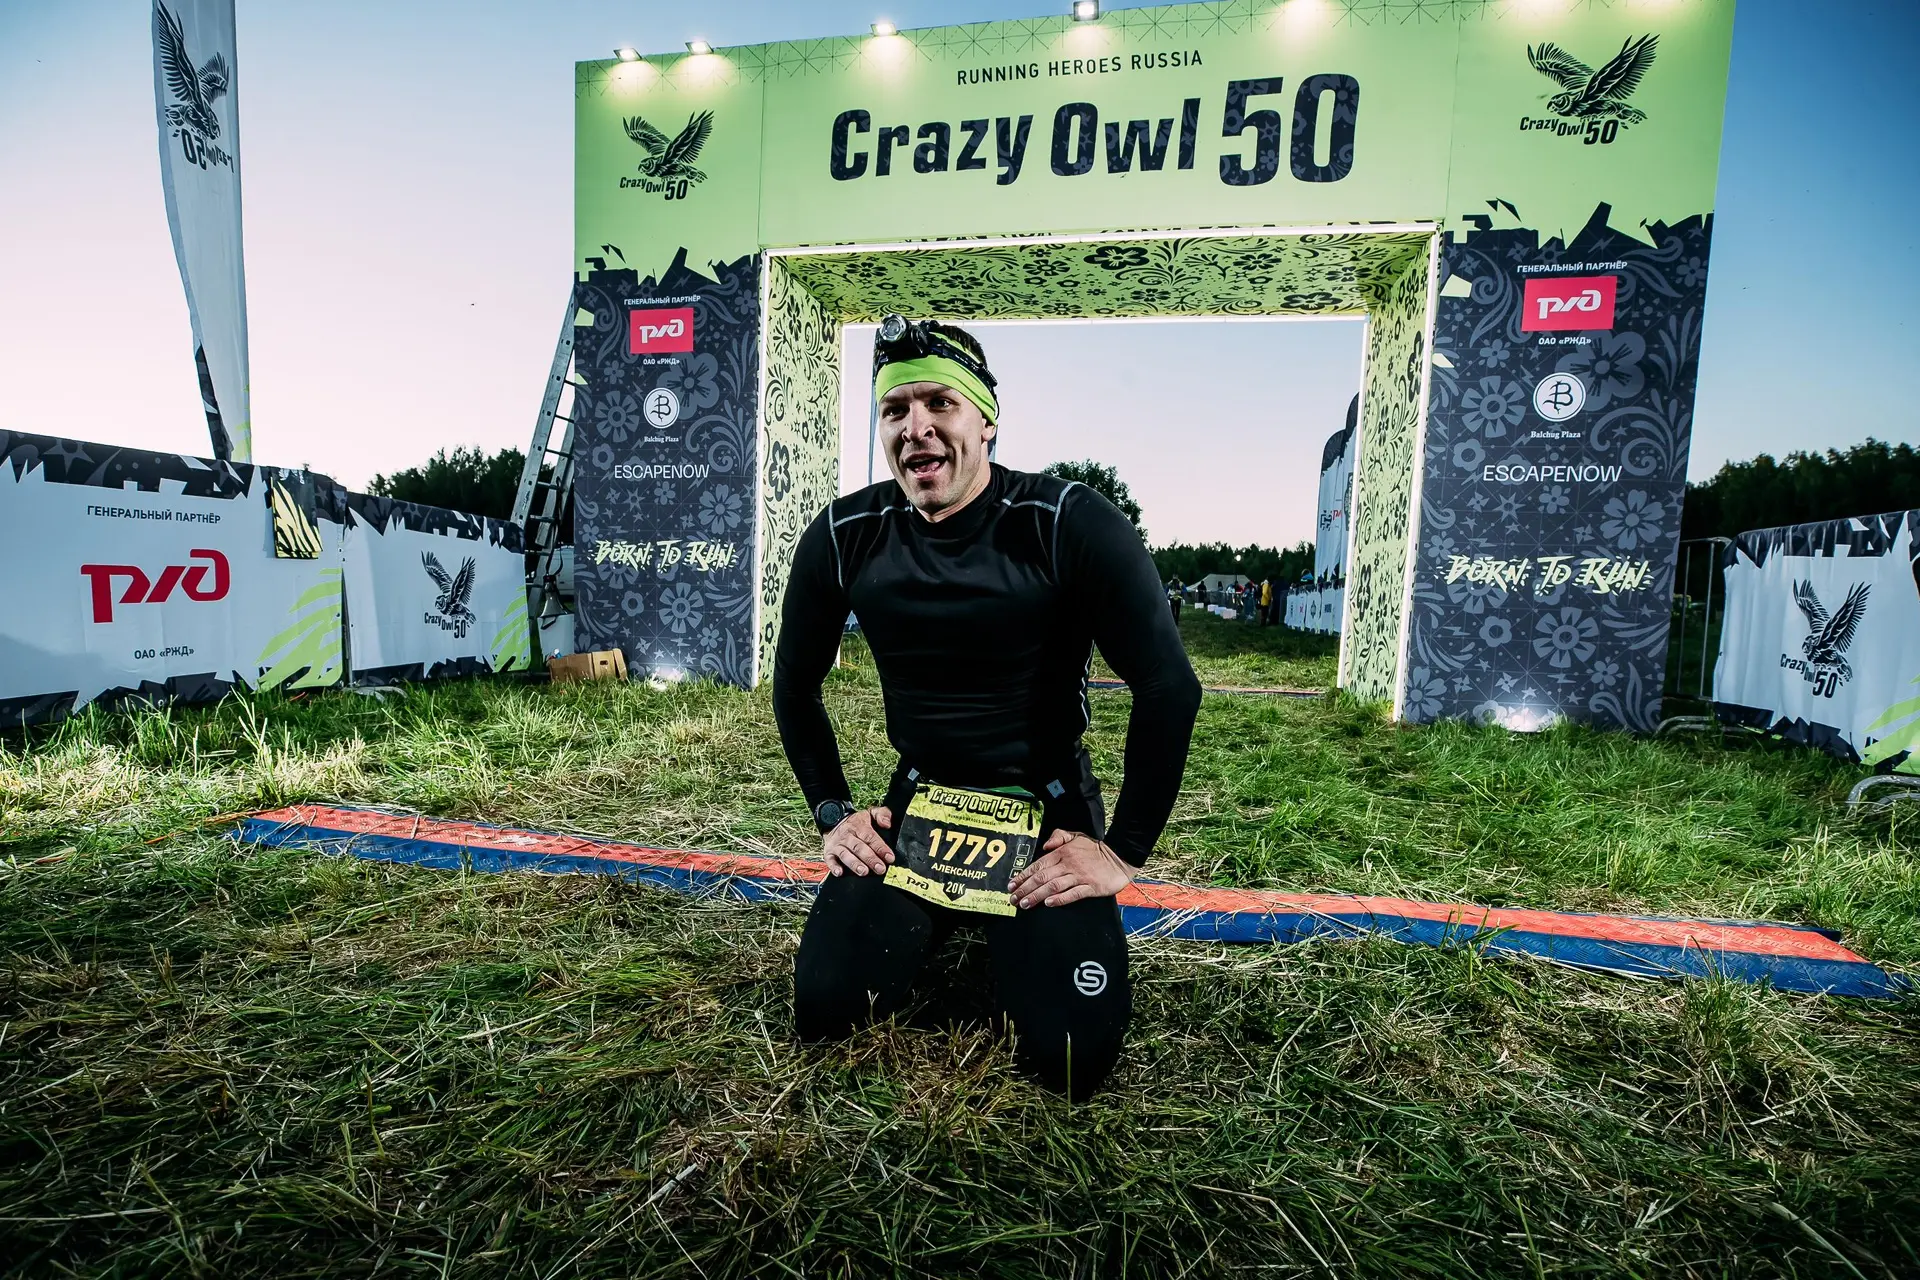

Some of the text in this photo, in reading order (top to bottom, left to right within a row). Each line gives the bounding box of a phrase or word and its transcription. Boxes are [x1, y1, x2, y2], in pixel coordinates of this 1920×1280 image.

[957, 49, 1203, 86] RUNNING HEROES RUSSIA
[829, 73, 1361, 187] Crazy Owl 50
[1519, 116, 1619, 146] Crazy Owl 50
[619, 176, 689, 201] Crazy Owl 50
[1517, 260, 1628, 273] ГЕНЕРАЛЬНЫЙ ПАРТНЁР
[623, 294, 701, 306] ГЕНЕРАЛЬНЫЙ ПАРТНЁР
[1538, 336, 1592, 346] ОАО «РЖД»
[643, 358, 656, 366] ОАО
[1530, 430, 1581, 440] Balchug Plaza
[614, 464, 710, 479] ESCAPENOW
[1482, 464, 1623, 482] ESCAPENOW
[87, 505, 221, 524] ГЕНЕРАЛЬНЫЙ ПАРТНЁР
[594, 539, 651, 572] BORN
[685, 539, 737, 573] RUN
[1446, 555, 1530, 593] BORN
[1576, 555, 1651, 595] RUN
[424, 612, 466, 639] Crazy Owl 50
[134, 645, 195, 660] ОАО «РЖД»
[1780, 653, 1807, 675] Crazy
[1812, 670, 1838, 699] 50
[930, 788, 1025, 824] Crazy Owl 50
[928, 827, 1007, 868] 1779
[931, 862, 988, 880] АЛЕКСАНДР
